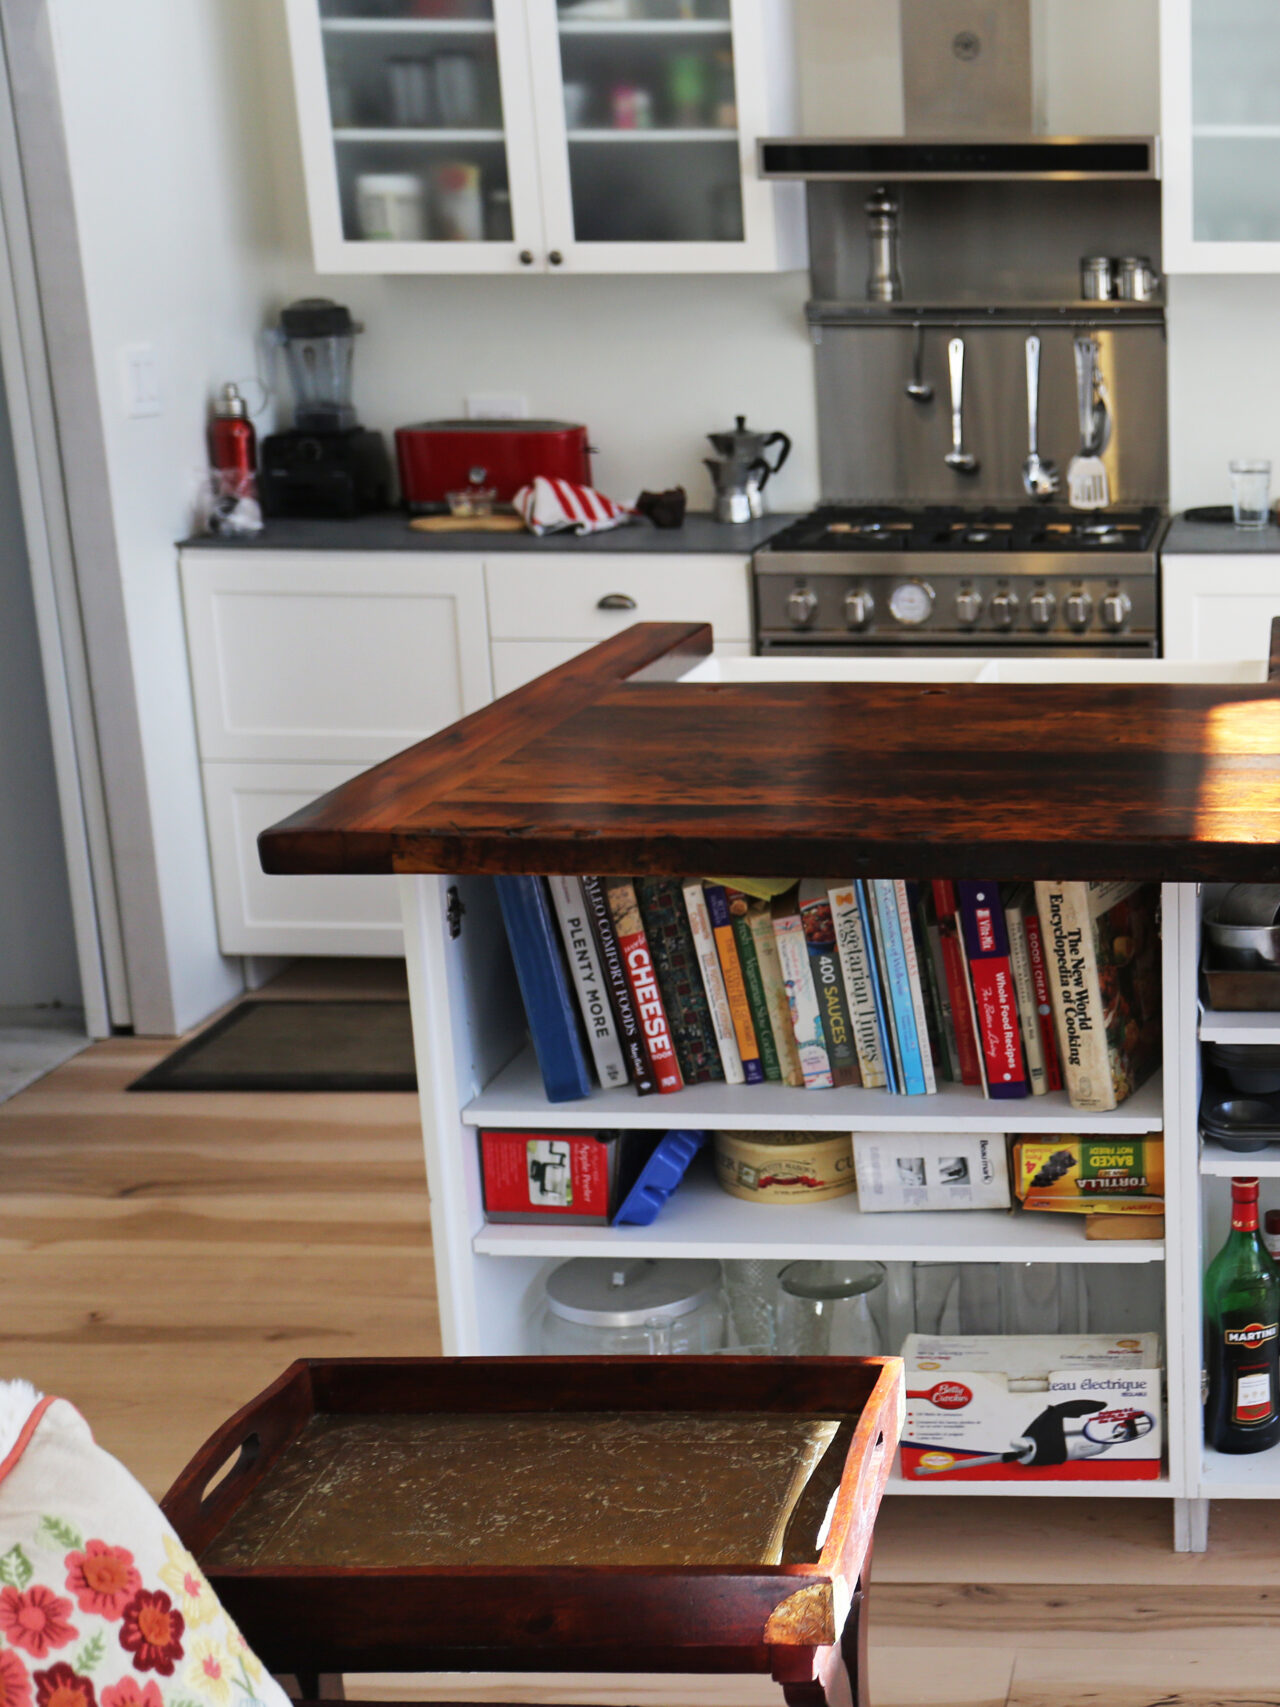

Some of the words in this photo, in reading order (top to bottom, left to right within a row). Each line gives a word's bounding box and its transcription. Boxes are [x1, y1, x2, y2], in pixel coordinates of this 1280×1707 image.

[1029, 932, 1040, 964] GOOD
[1049, 893, 1071, 987] Encyclopedia
[1067, 928, 1082, 956] The
[567, 918, 596, 983] PLENTY
[586, 990, 609, 1038] MORE
[597, 920, 625, 985] COMFORT
[615, 990, 638, 1037] FOODS
[746, 957, 765, 1007] Vegetarian
[819, 956, 835, 984] 400
[838, 908, 871, 1005] Vegetarian
[859, 1007, 879, 1063] Times
[1034, 969, 1047, 1002] CHEAP
[1070, 957, 1086, 988] New
[628, 949, 671, 1053] CHEESE
[995, 972, 1008, 1003] Whole
[1062, 991, 1075, 1007] of
[824, 986, 847, 1045] SAUCES
[1000, 1005, 1012, 1030] Food
[1074, 989, 1092, 1031] World
[1003, 1031, 1017, 1069] Recipes
[1064, 1007, 1081, 1067] Cooking
[1025, 1161, 1037, 1174] 4
[1090, 1155, 1134, 1166] BAKED
[1076, 1177, 1148, 1187] TORTILLA
[1229, 1327, 1277, 1342] MARTINI
[938, 1384, 964, 1395] Betty
[1081, 1378, 1147, 1392] électrique
